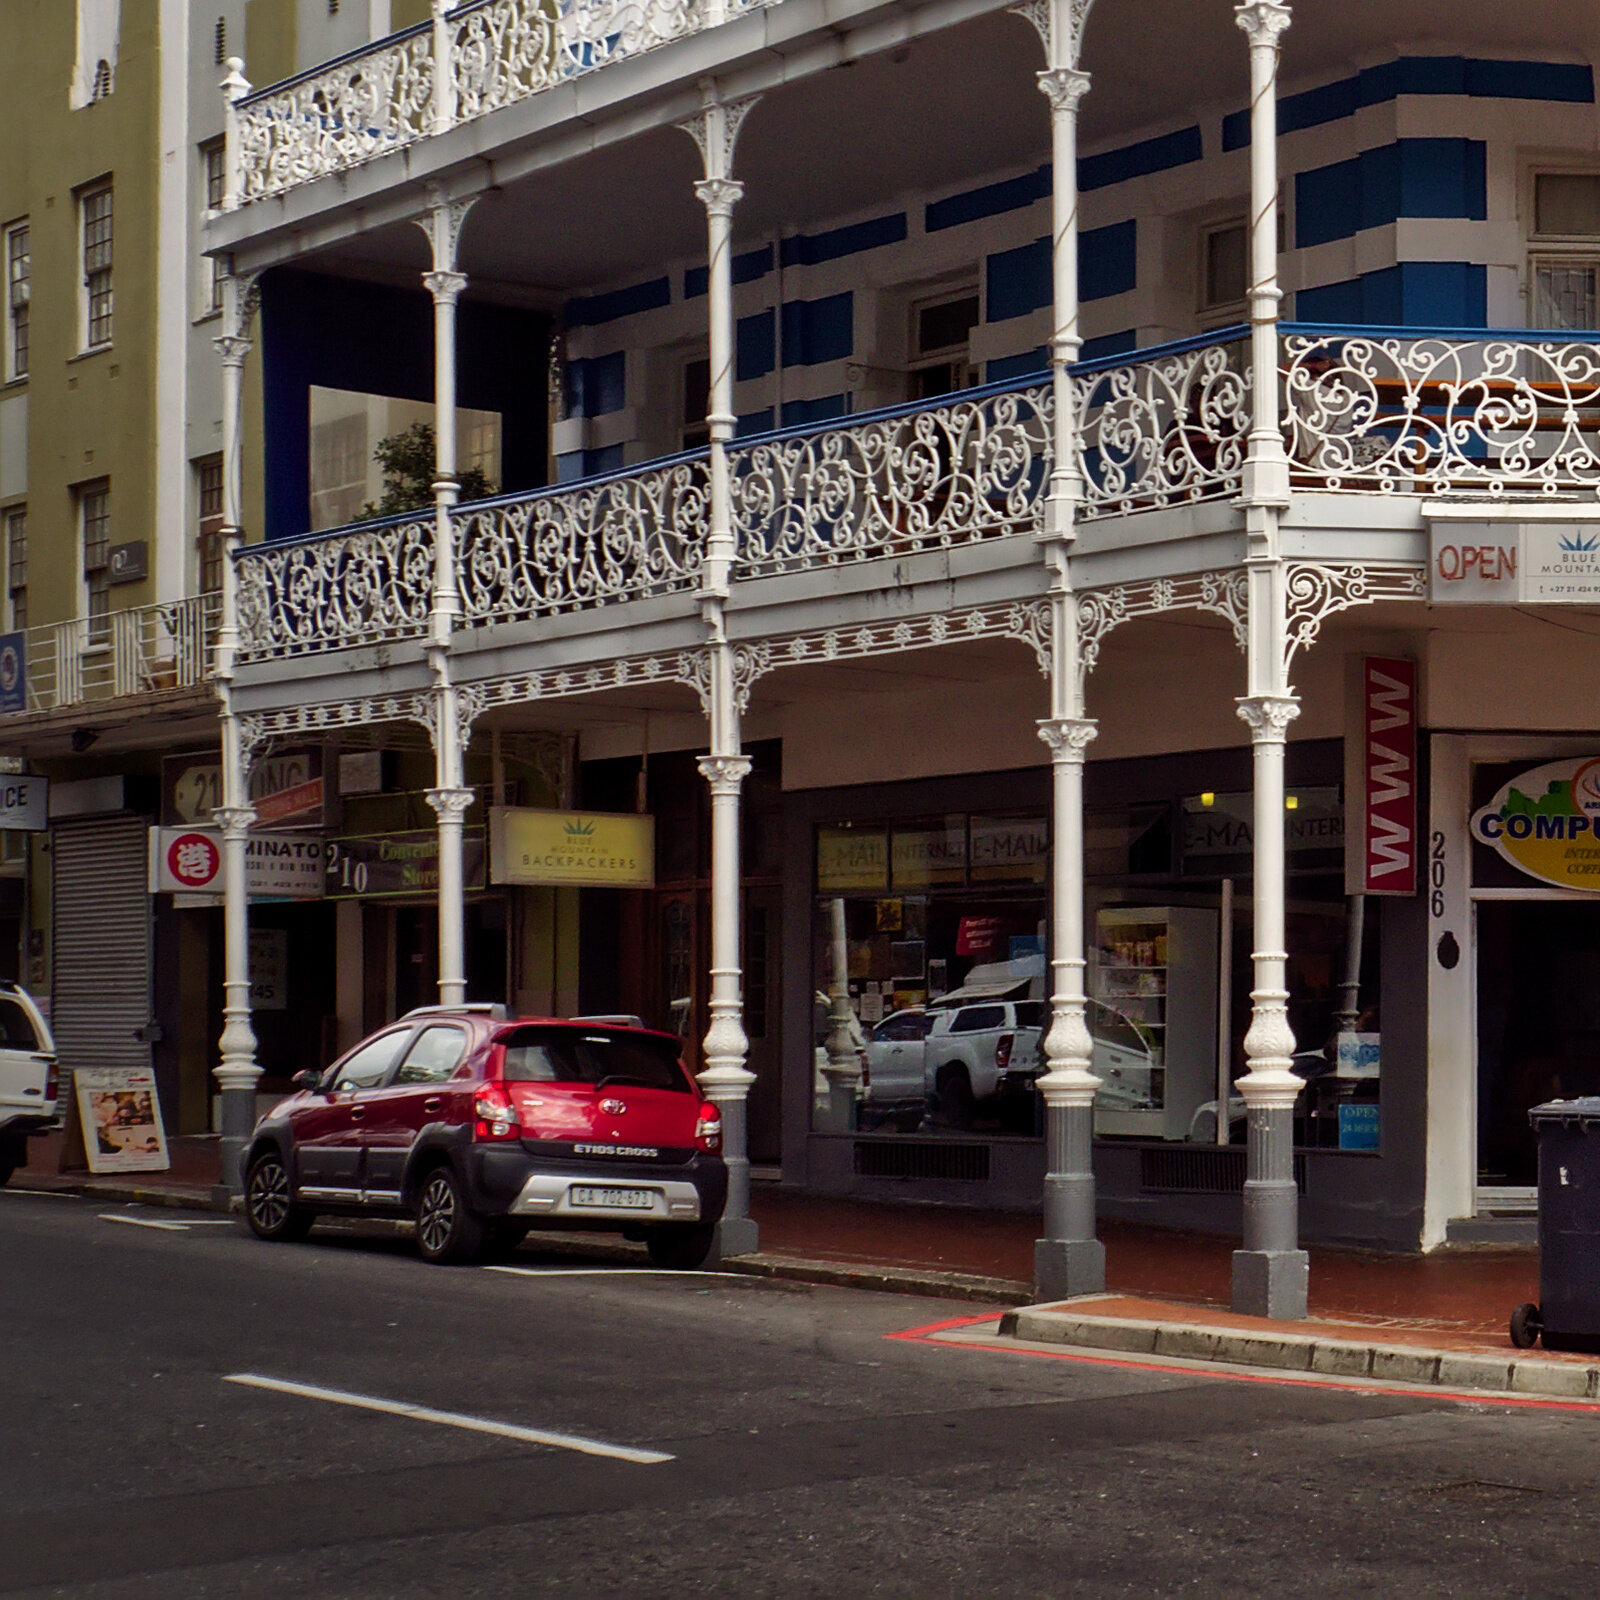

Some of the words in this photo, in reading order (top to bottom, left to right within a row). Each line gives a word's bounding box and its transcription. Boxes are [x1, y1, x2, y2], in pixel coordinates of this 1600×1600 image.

[1438, 545, 1517, 580] OPEN
[1562, 553, 1597, 563] BLUE
[1565, 586, 1575, 594] 21
[1369, 668, 1410, 879] WWW
[193, 772, 223, 818] 21
[522, 854, 636, 870] BACKPACKERS
[1430, 830, 1446, 918] 206
[574, 1144, 616, 1155] ETIOS
[616, 1146, 658, 1157] CROSS
[579, 1188, 594, 1203] CA
